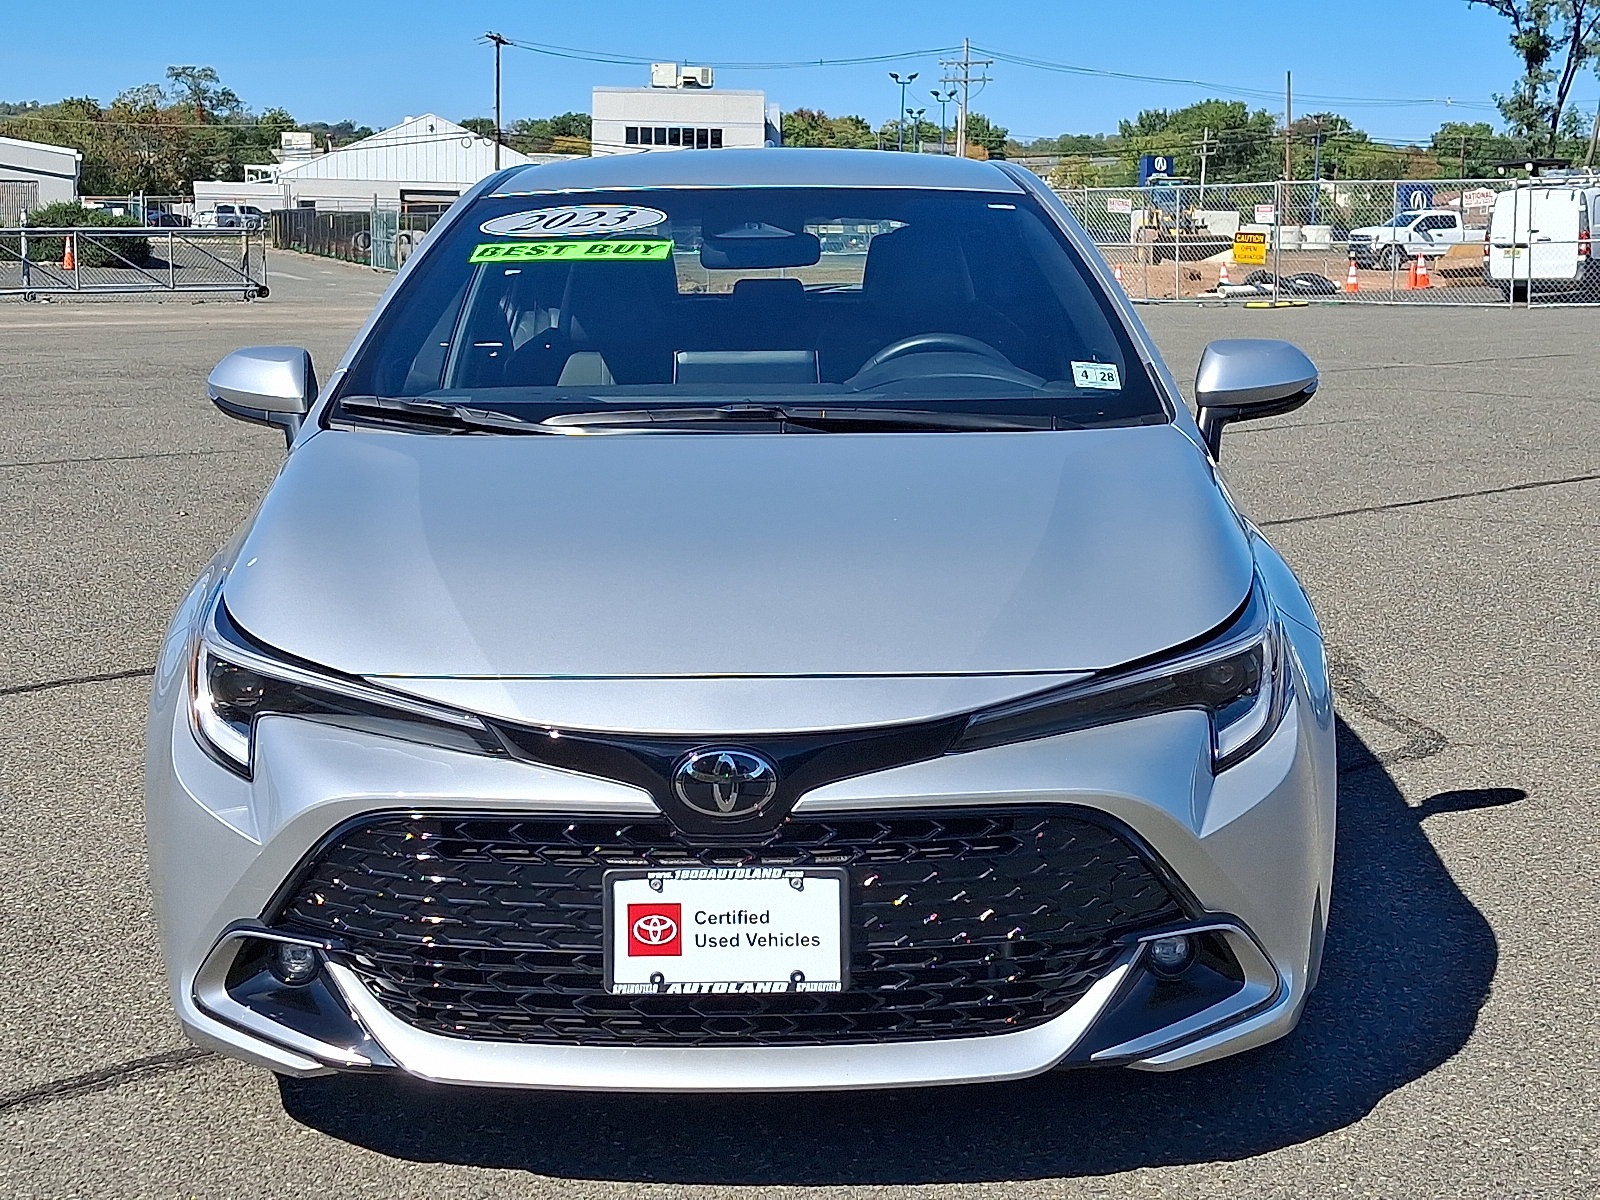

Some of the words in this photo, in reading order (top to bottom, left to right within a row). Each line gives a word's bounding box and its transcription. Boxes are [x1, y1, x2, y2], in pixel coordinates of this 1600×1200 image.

[1464, 191, 1493, 200] NATIONAL
[508, 210, 637, 231] 2023
[1236, 234, 1264, 243] CAUTION
[476, 244, 578, 257] BEST
[583, 244, 668, 255] BUY
[1081, 370, 1088, 379] 4
[1100, 371, 1114, 381] 28
[694, 909, 770, 925] Certified
[694, 932, 740, 948] Used
[745, 931, 821, 947] Vehicles
[666, 982, 789, 994] AUTOLAND
